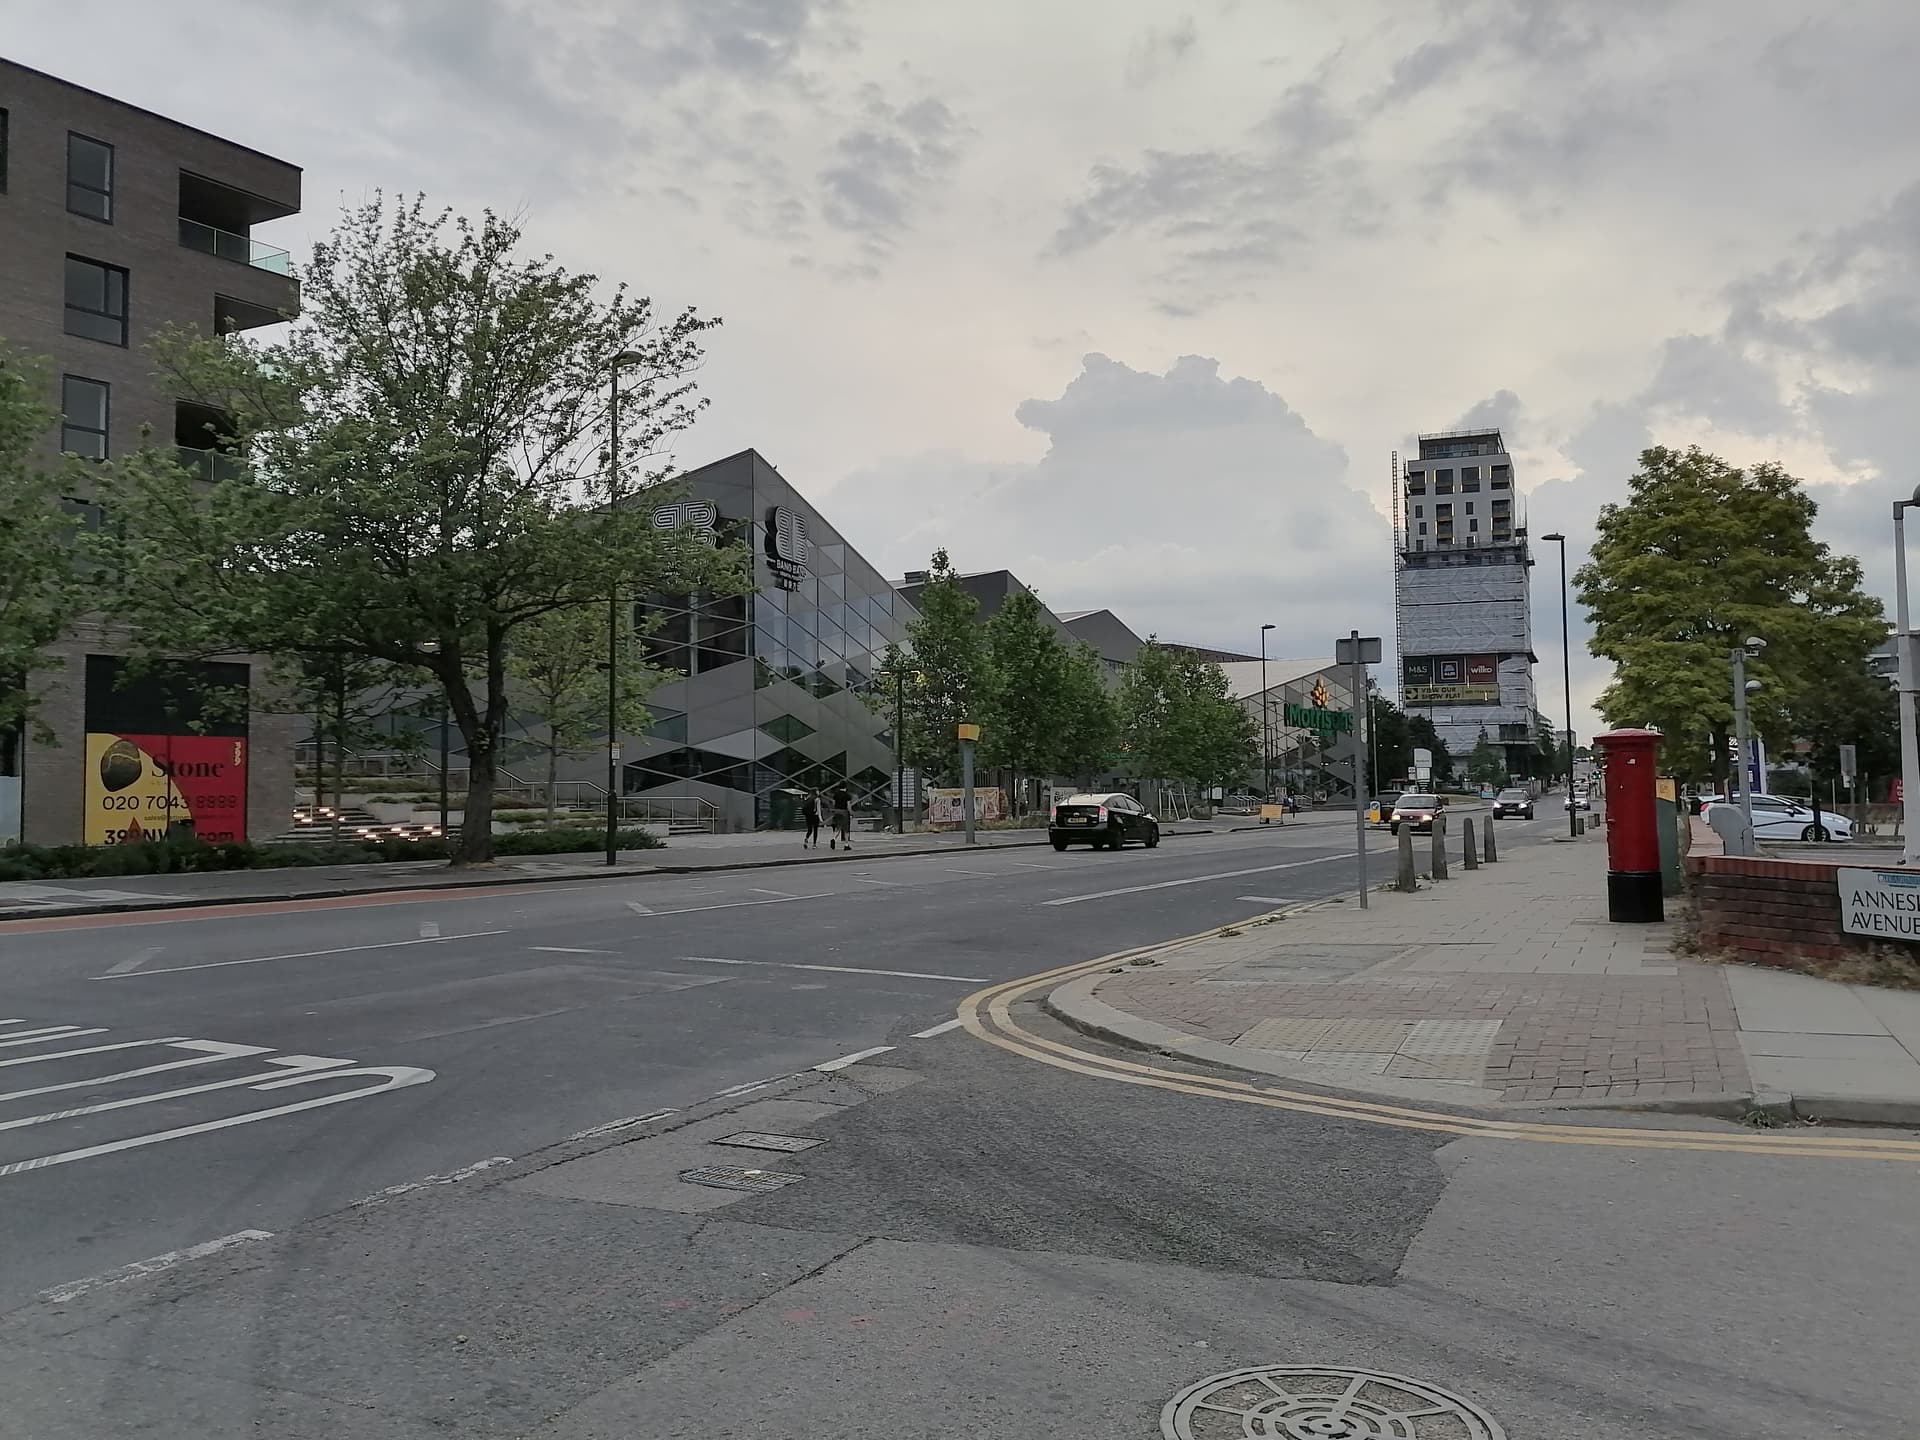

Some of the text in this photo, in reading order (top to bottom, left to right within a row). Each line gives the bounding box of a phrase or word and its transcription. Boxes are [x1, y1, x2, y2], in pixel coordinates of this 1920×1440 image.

[1408, 665, 1428, 673] M&S
[1470, 665, 1493, 673] wilko
[102, 796, 140, 810] 020
[145, 795, 190, 810] 7043
[1850, 912, 1920, 935] AVENUE
